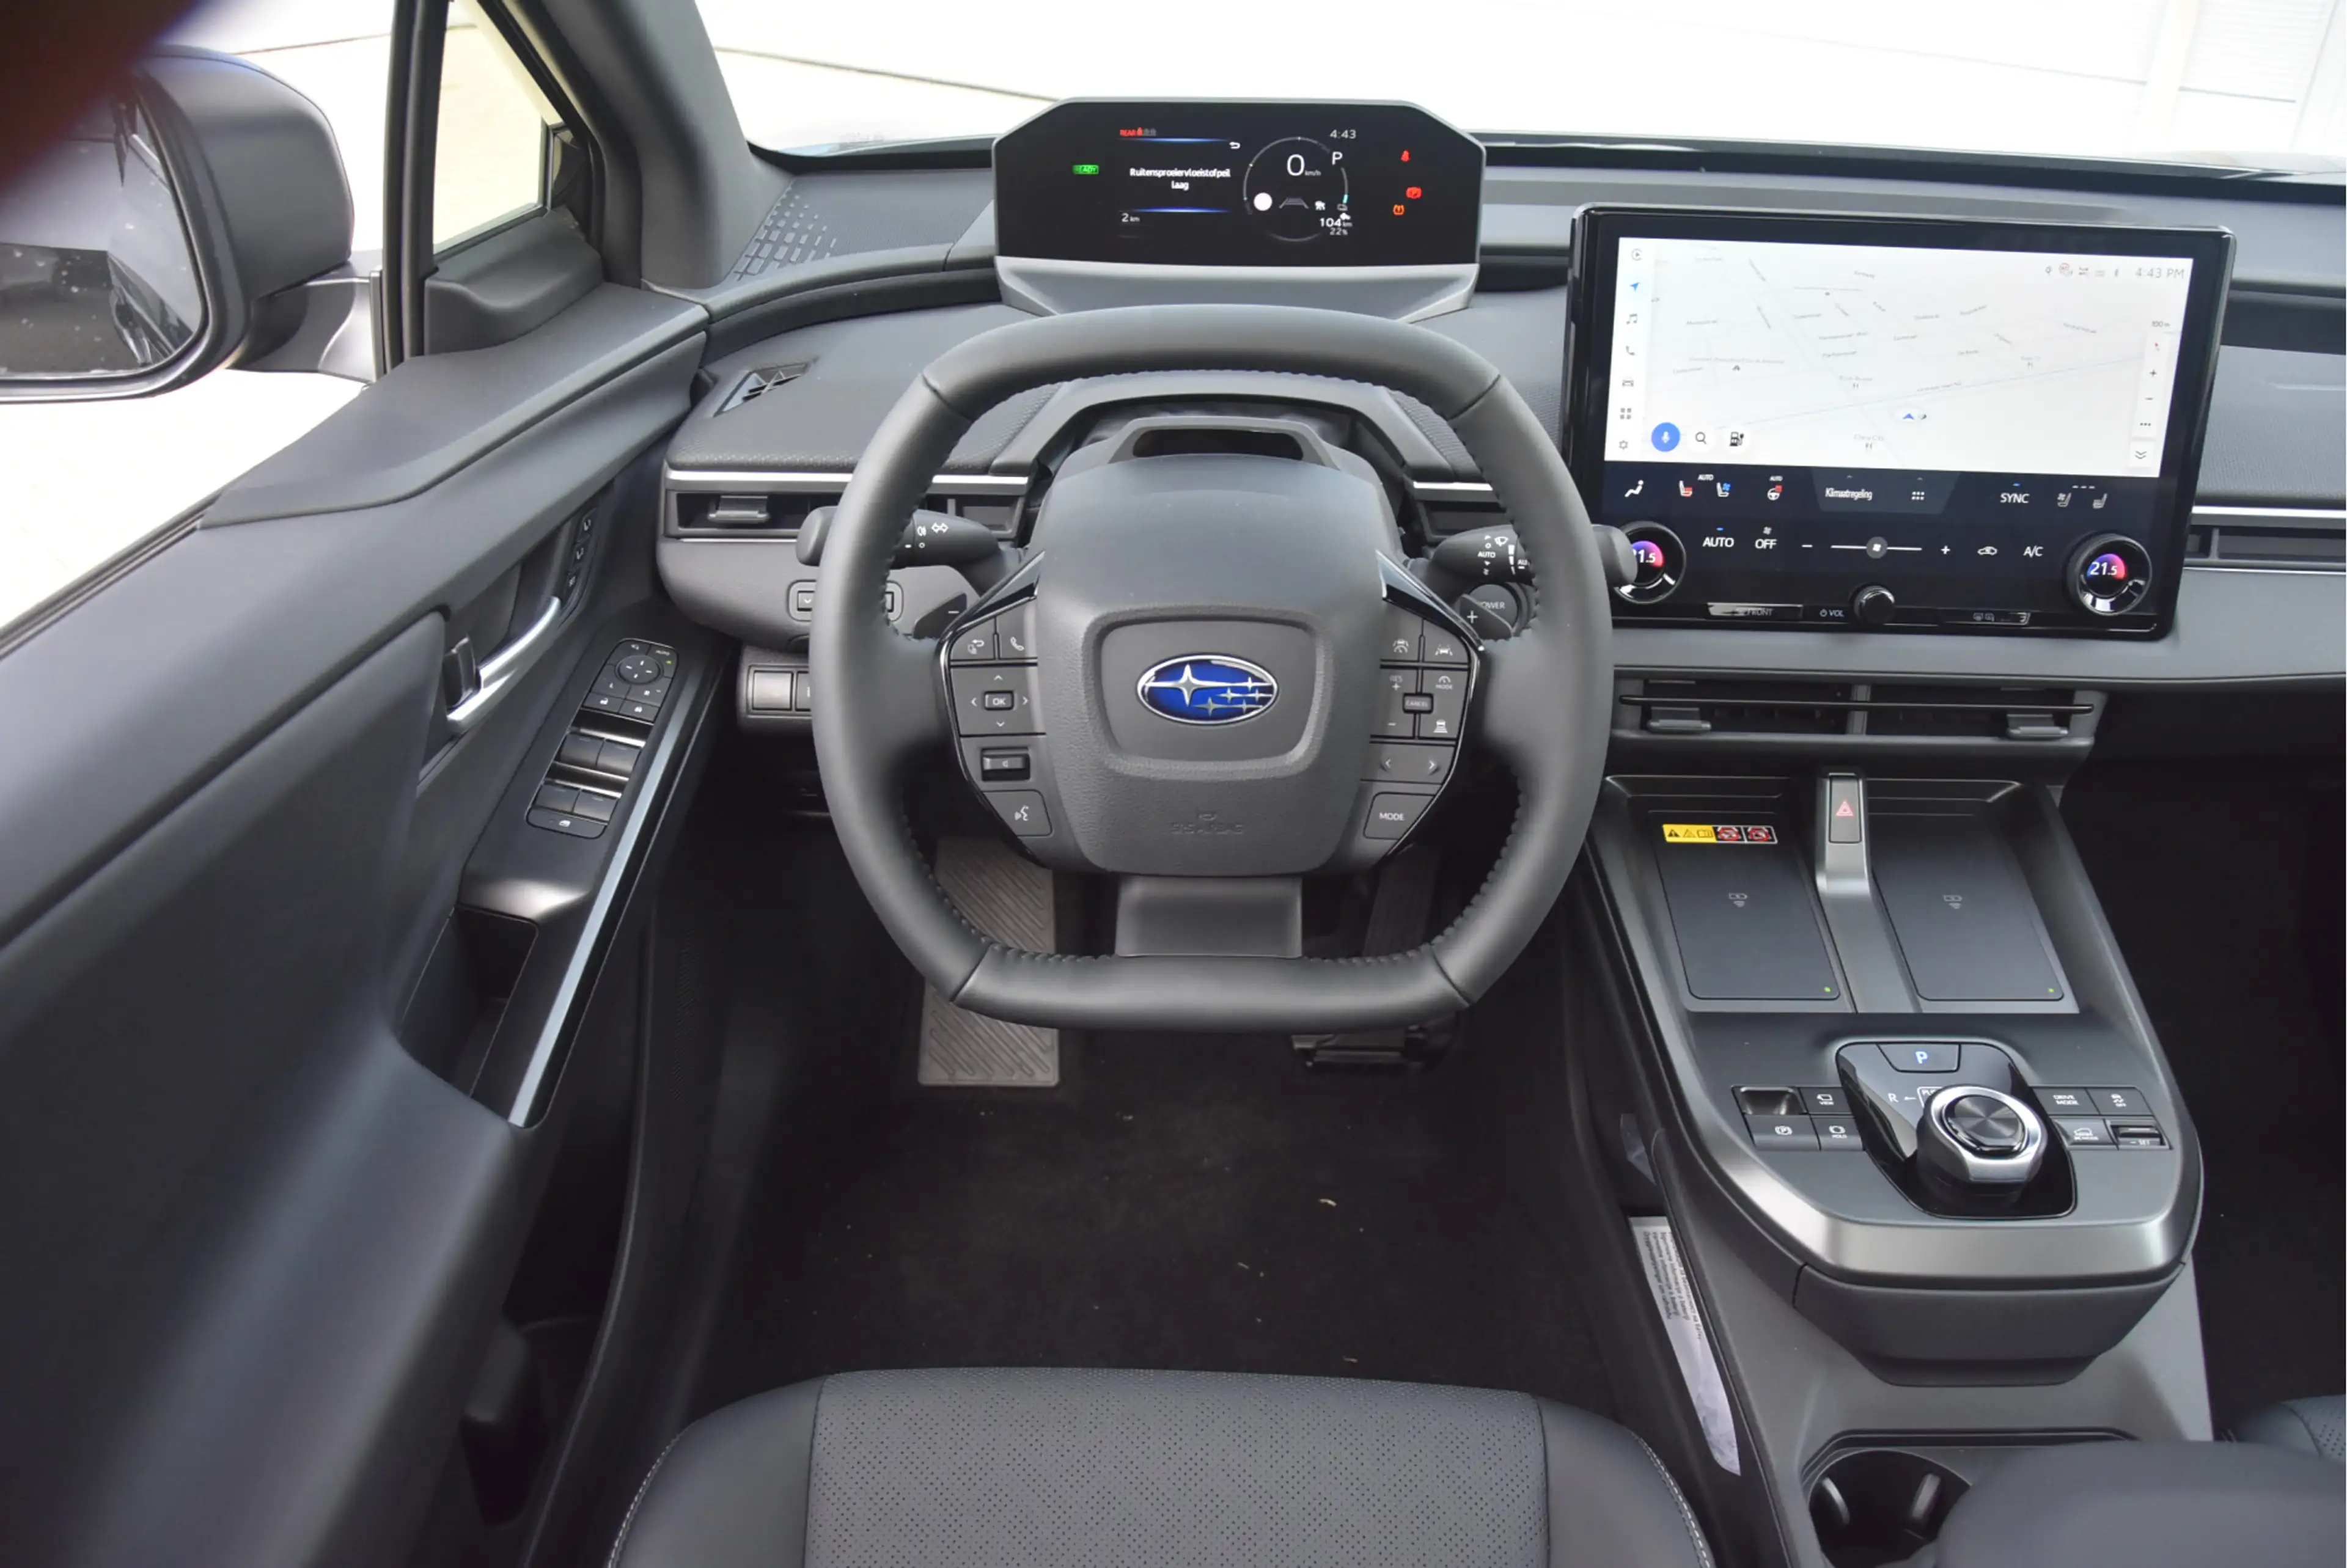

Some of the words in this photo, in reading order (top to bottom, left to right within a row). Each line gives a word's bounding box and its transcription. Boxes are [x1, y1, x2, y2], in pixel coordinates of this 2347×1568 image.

[1330, 130, 1356, 139] 4:43
[1332, 151, 1343, 166] P
[1287, 154, 1305, 176] 0
[1122, 213, 1129, 222] 2
[1320, 218, 1341, 227] 104
[2135, 267, 2162, 278] 4:43
[2166, 268, 2184, 279] PM
[2000, 493, 2030, 504] SYNC
[1702, 537, 1735, 548] AUTO
[1755, 538, 1777, 549] OFF
[2022, 546, 2044, 557] A/C
[2090, 562, 2117, 576] 21.5
[1915, 1050, 1928, 1064] P
[1887, 1093, 1899, 1102] R
